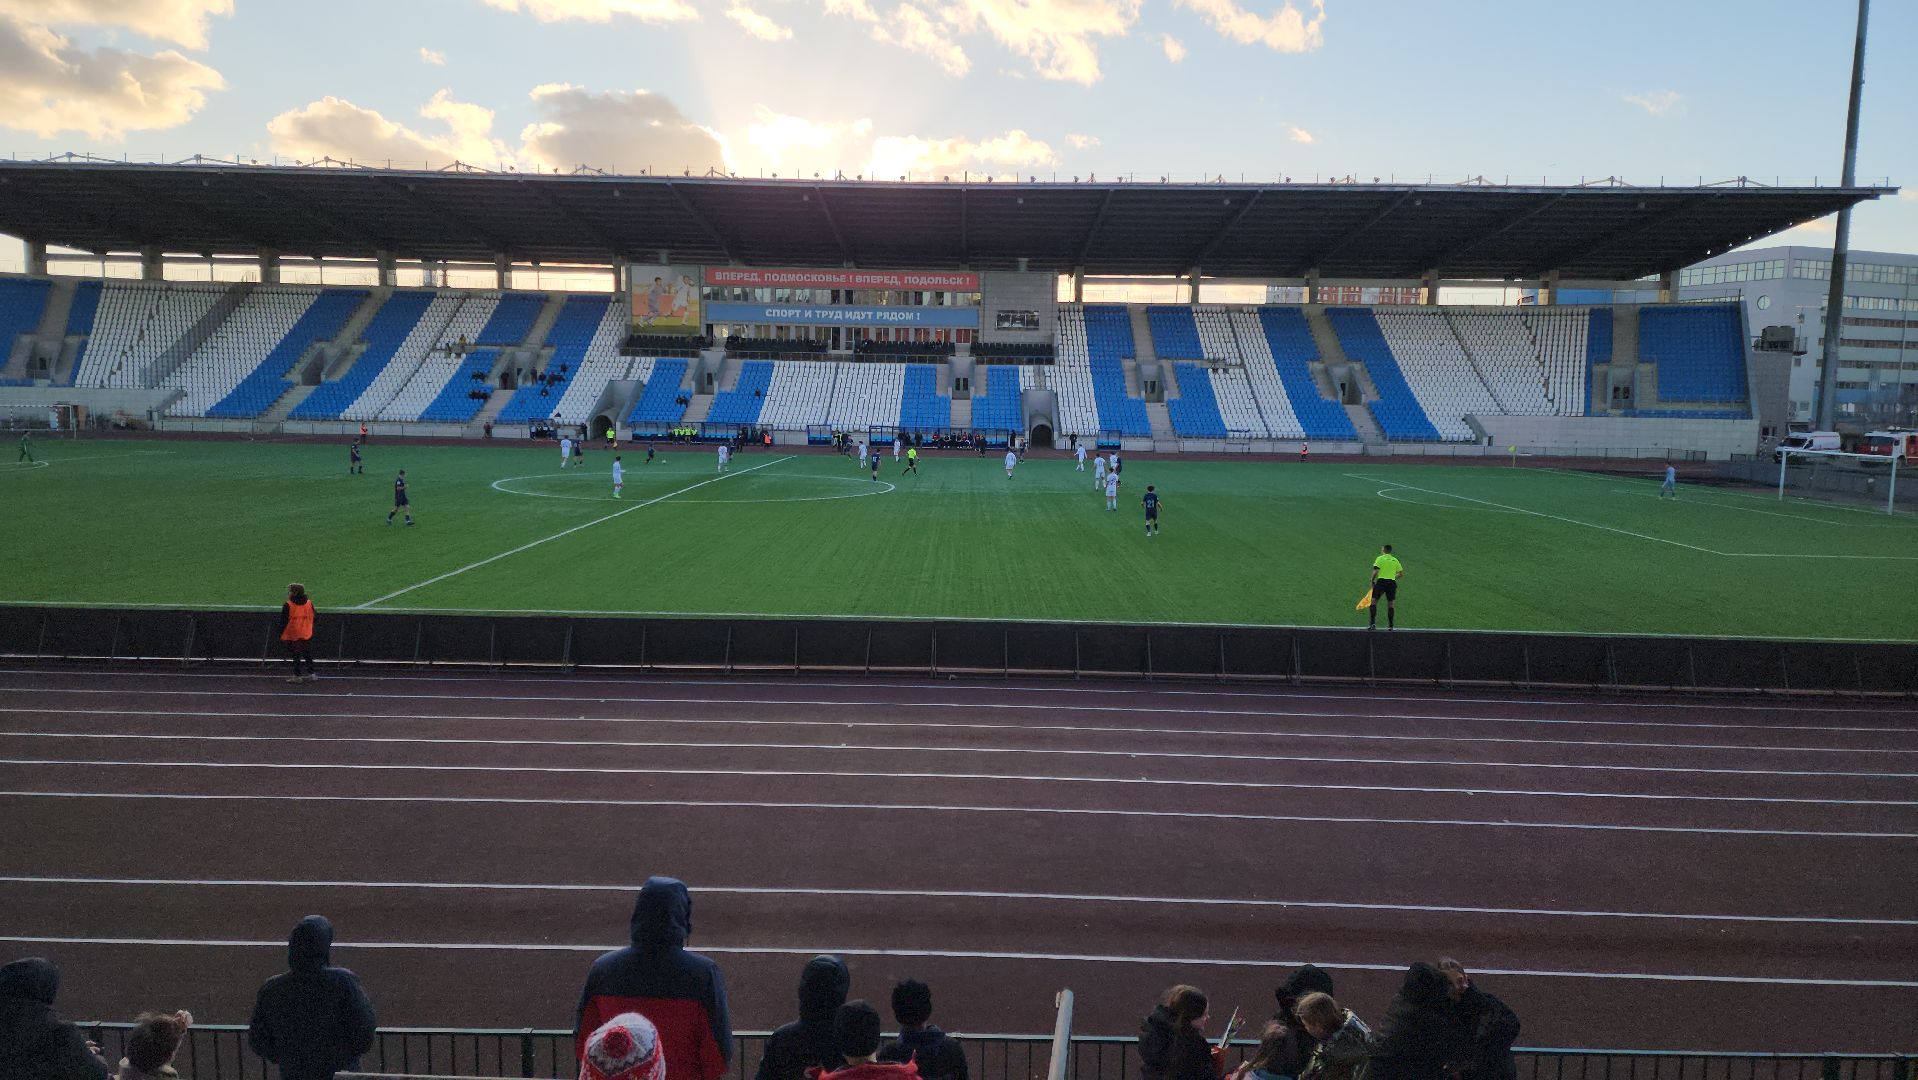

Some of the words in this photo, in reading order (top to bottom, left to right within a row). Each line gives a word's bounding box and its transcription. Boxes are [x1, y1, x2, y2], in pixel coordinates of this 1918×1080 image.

[715, 271, 760, 283] ВПЕРЕД,
[765, 273, 847, 283] ПОДМОСКОВЬЕ
[855, 275, 901, 286] ВПЕРЕД,
[904, 276, 963, 286] ПОДОЛЬСК
[765, 308, 801, 318] СПОРТ
[804, 309, 812, 318] И
[815, 310, 842, 320] ТРУД
[845, 311, 873, 321] ИДУТ
[876, 312, 914, 321] РЯДОМ
[1146, 500, 1155, 508] 21
